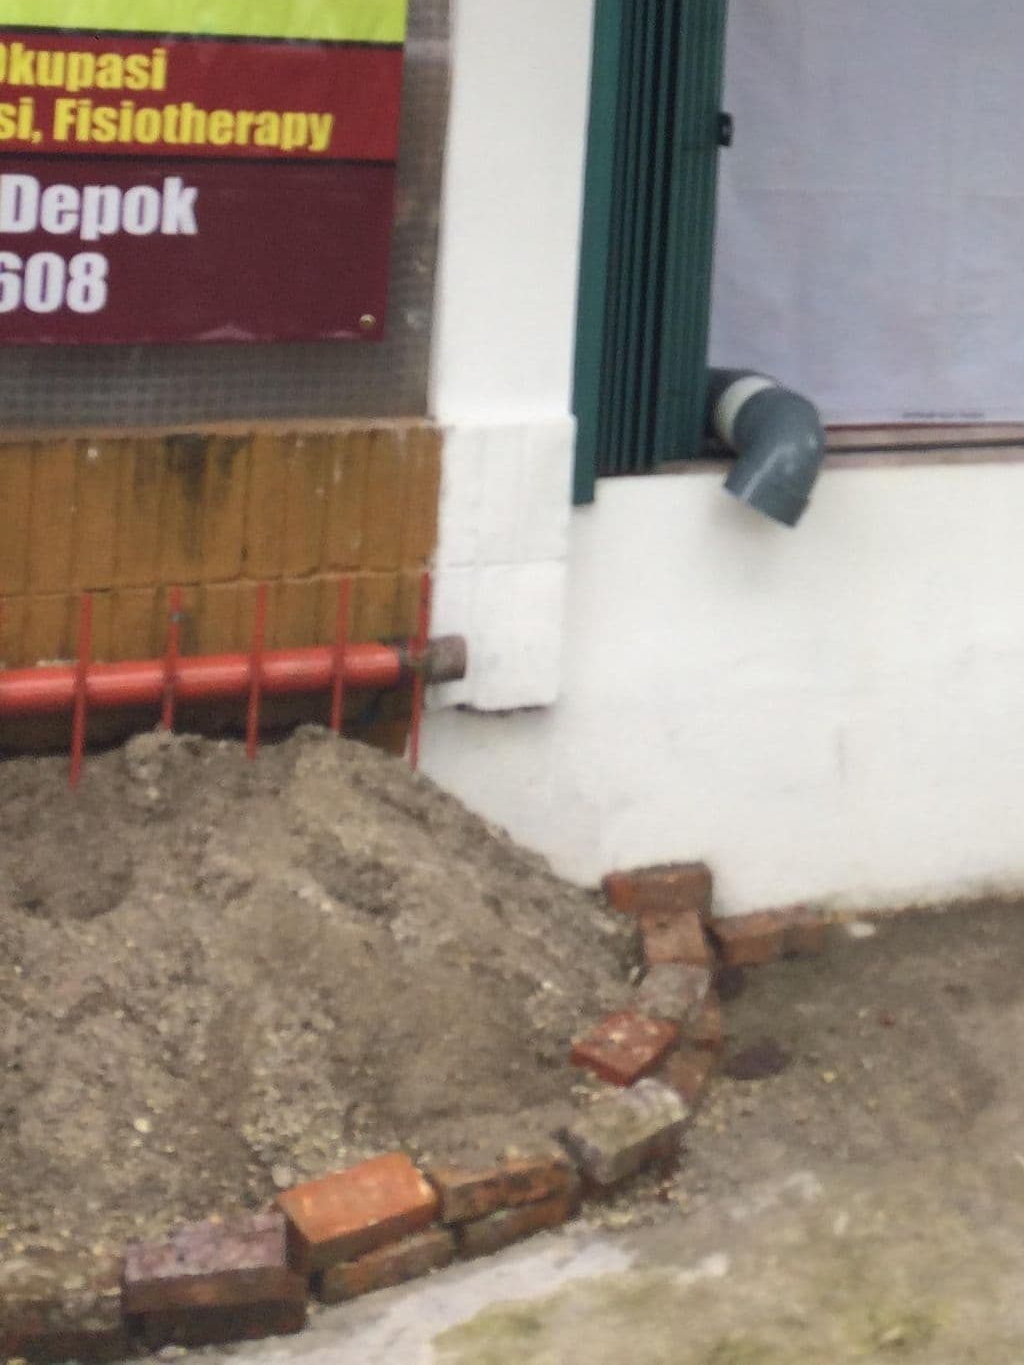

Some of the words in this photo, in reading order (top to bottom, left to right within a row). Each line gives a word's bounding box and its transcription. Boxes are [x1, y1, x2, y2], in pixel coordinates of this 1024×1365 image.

[0, 41, 167, 92] kupasi
[53, 97, 334, 152] Fisiotherapy
[0, 173, 198, 241] Depok
